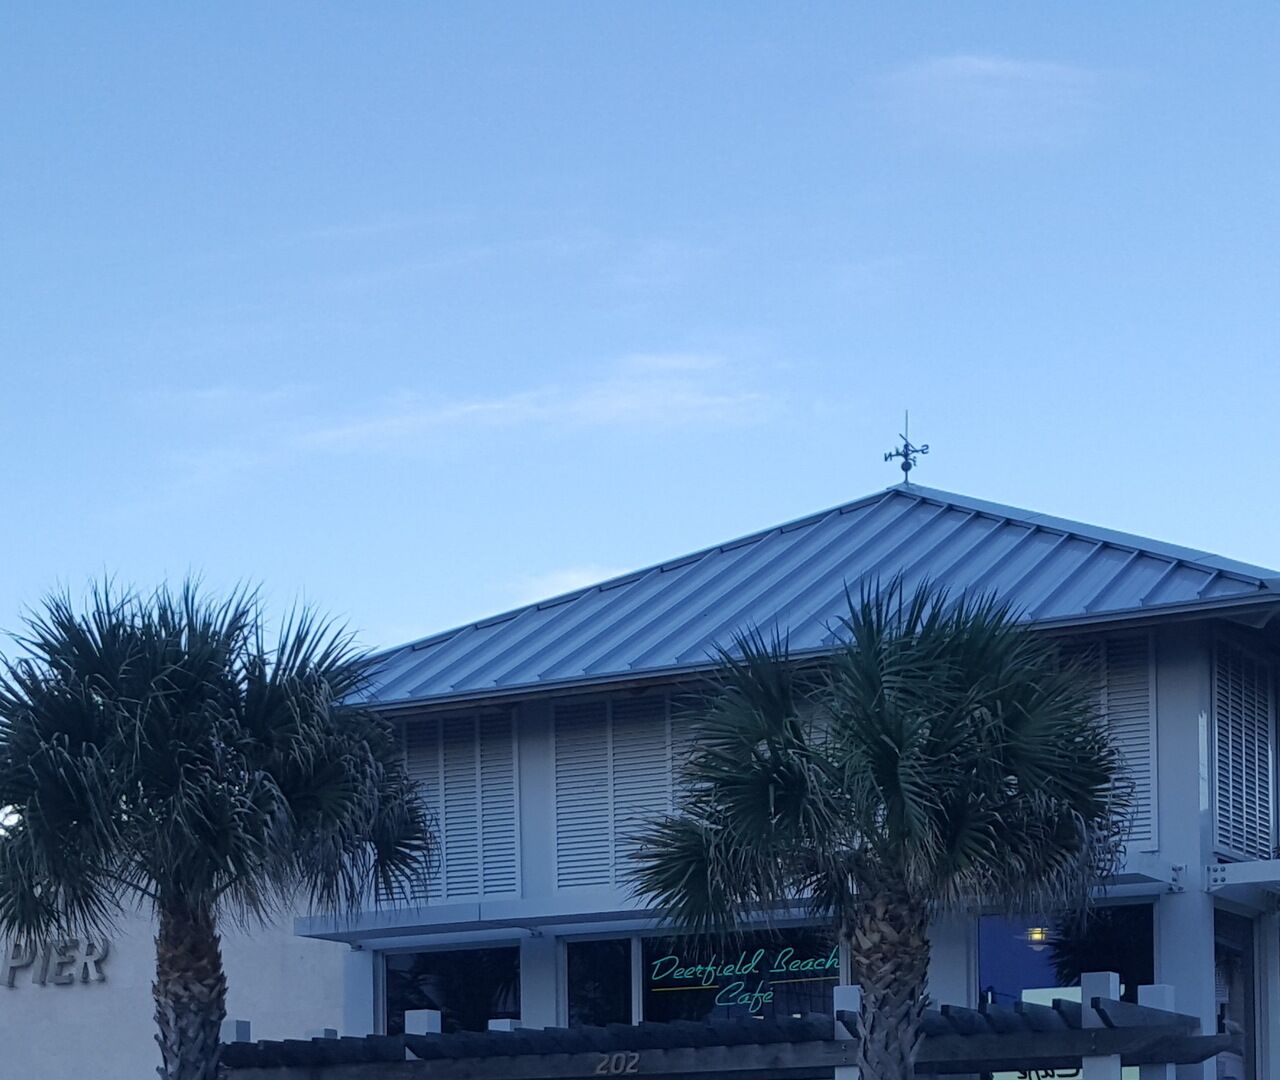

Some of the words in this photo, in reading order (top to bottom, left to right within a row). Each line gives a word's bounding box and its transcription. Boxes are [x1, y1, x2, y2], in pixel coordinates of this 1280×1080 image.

[651, 948, 765, 986] Deerfield
[768, 945, 841, 973] Beach
[596, 1053, 640, 1074] 202
